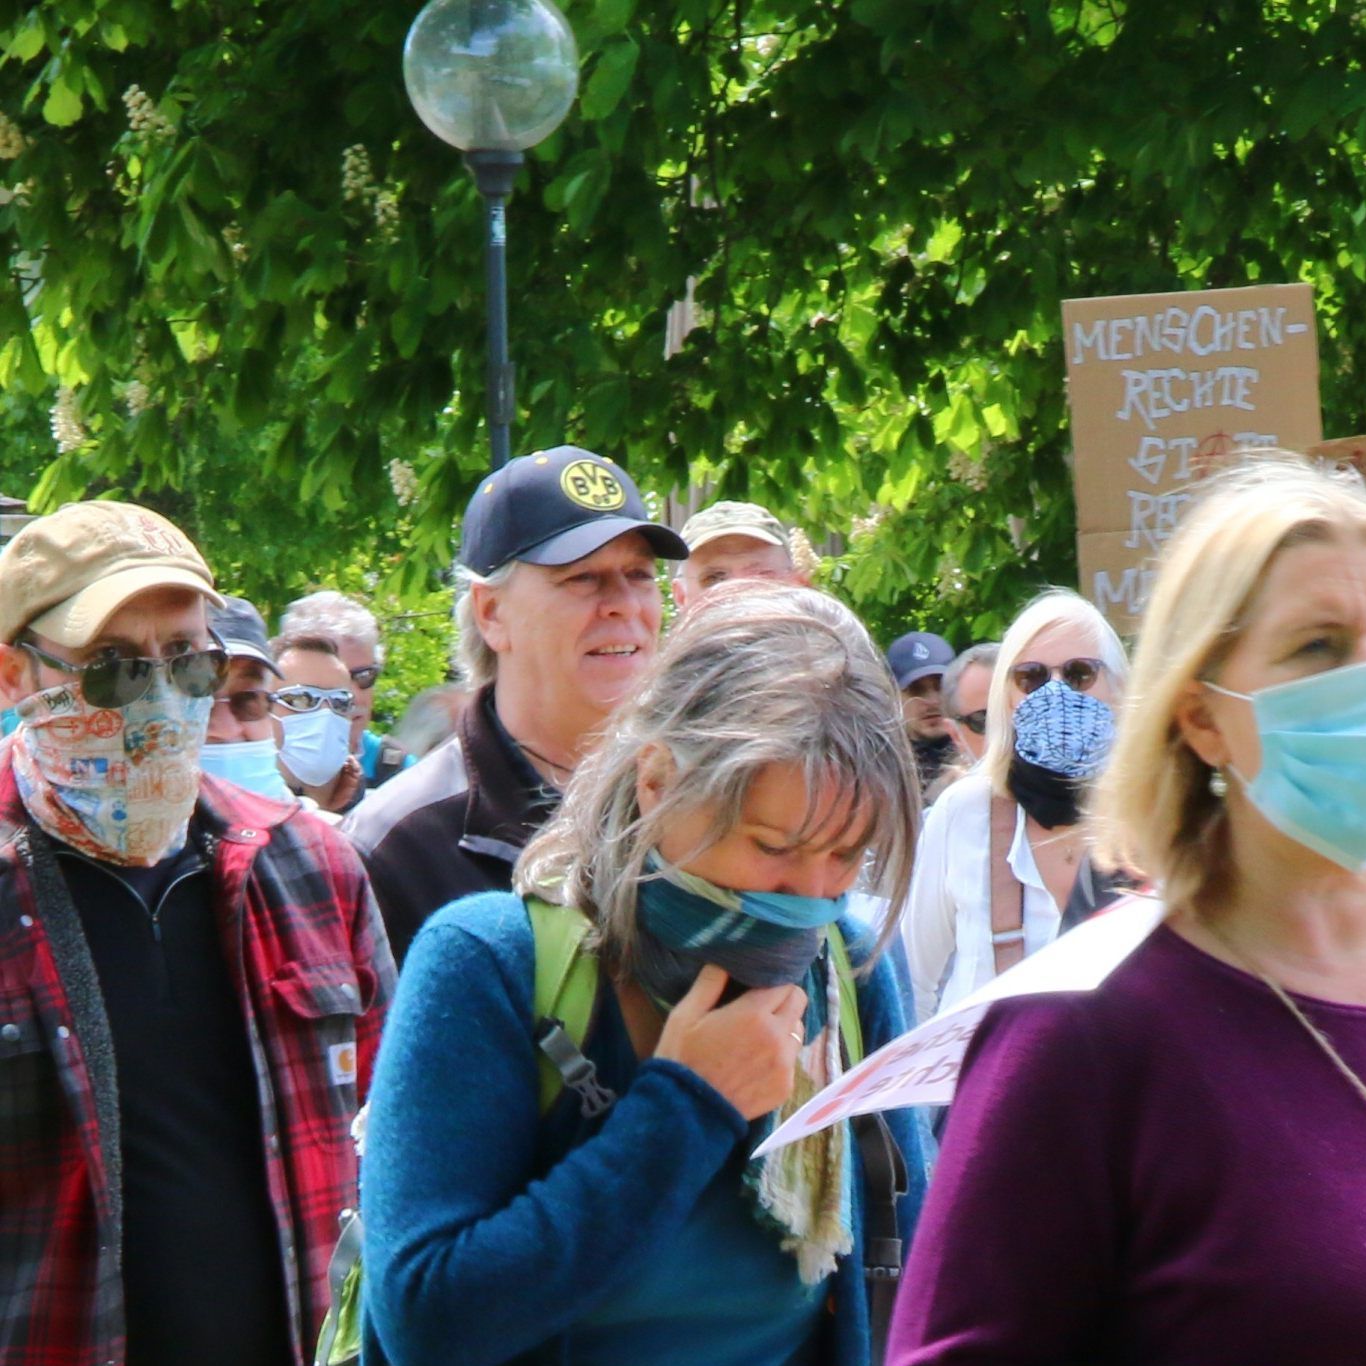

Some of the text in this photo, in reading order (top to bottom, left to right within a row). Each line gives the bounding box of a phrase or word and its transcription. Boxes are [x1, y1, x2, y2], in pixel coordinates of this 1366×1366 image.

[1072, 305, 1307, 364] MENSCHEN-
[1116, 366, 1259, 430] RECHTE
[570, 462, 619, 496] BVB
[1127, 427, 1279, 485] STA
